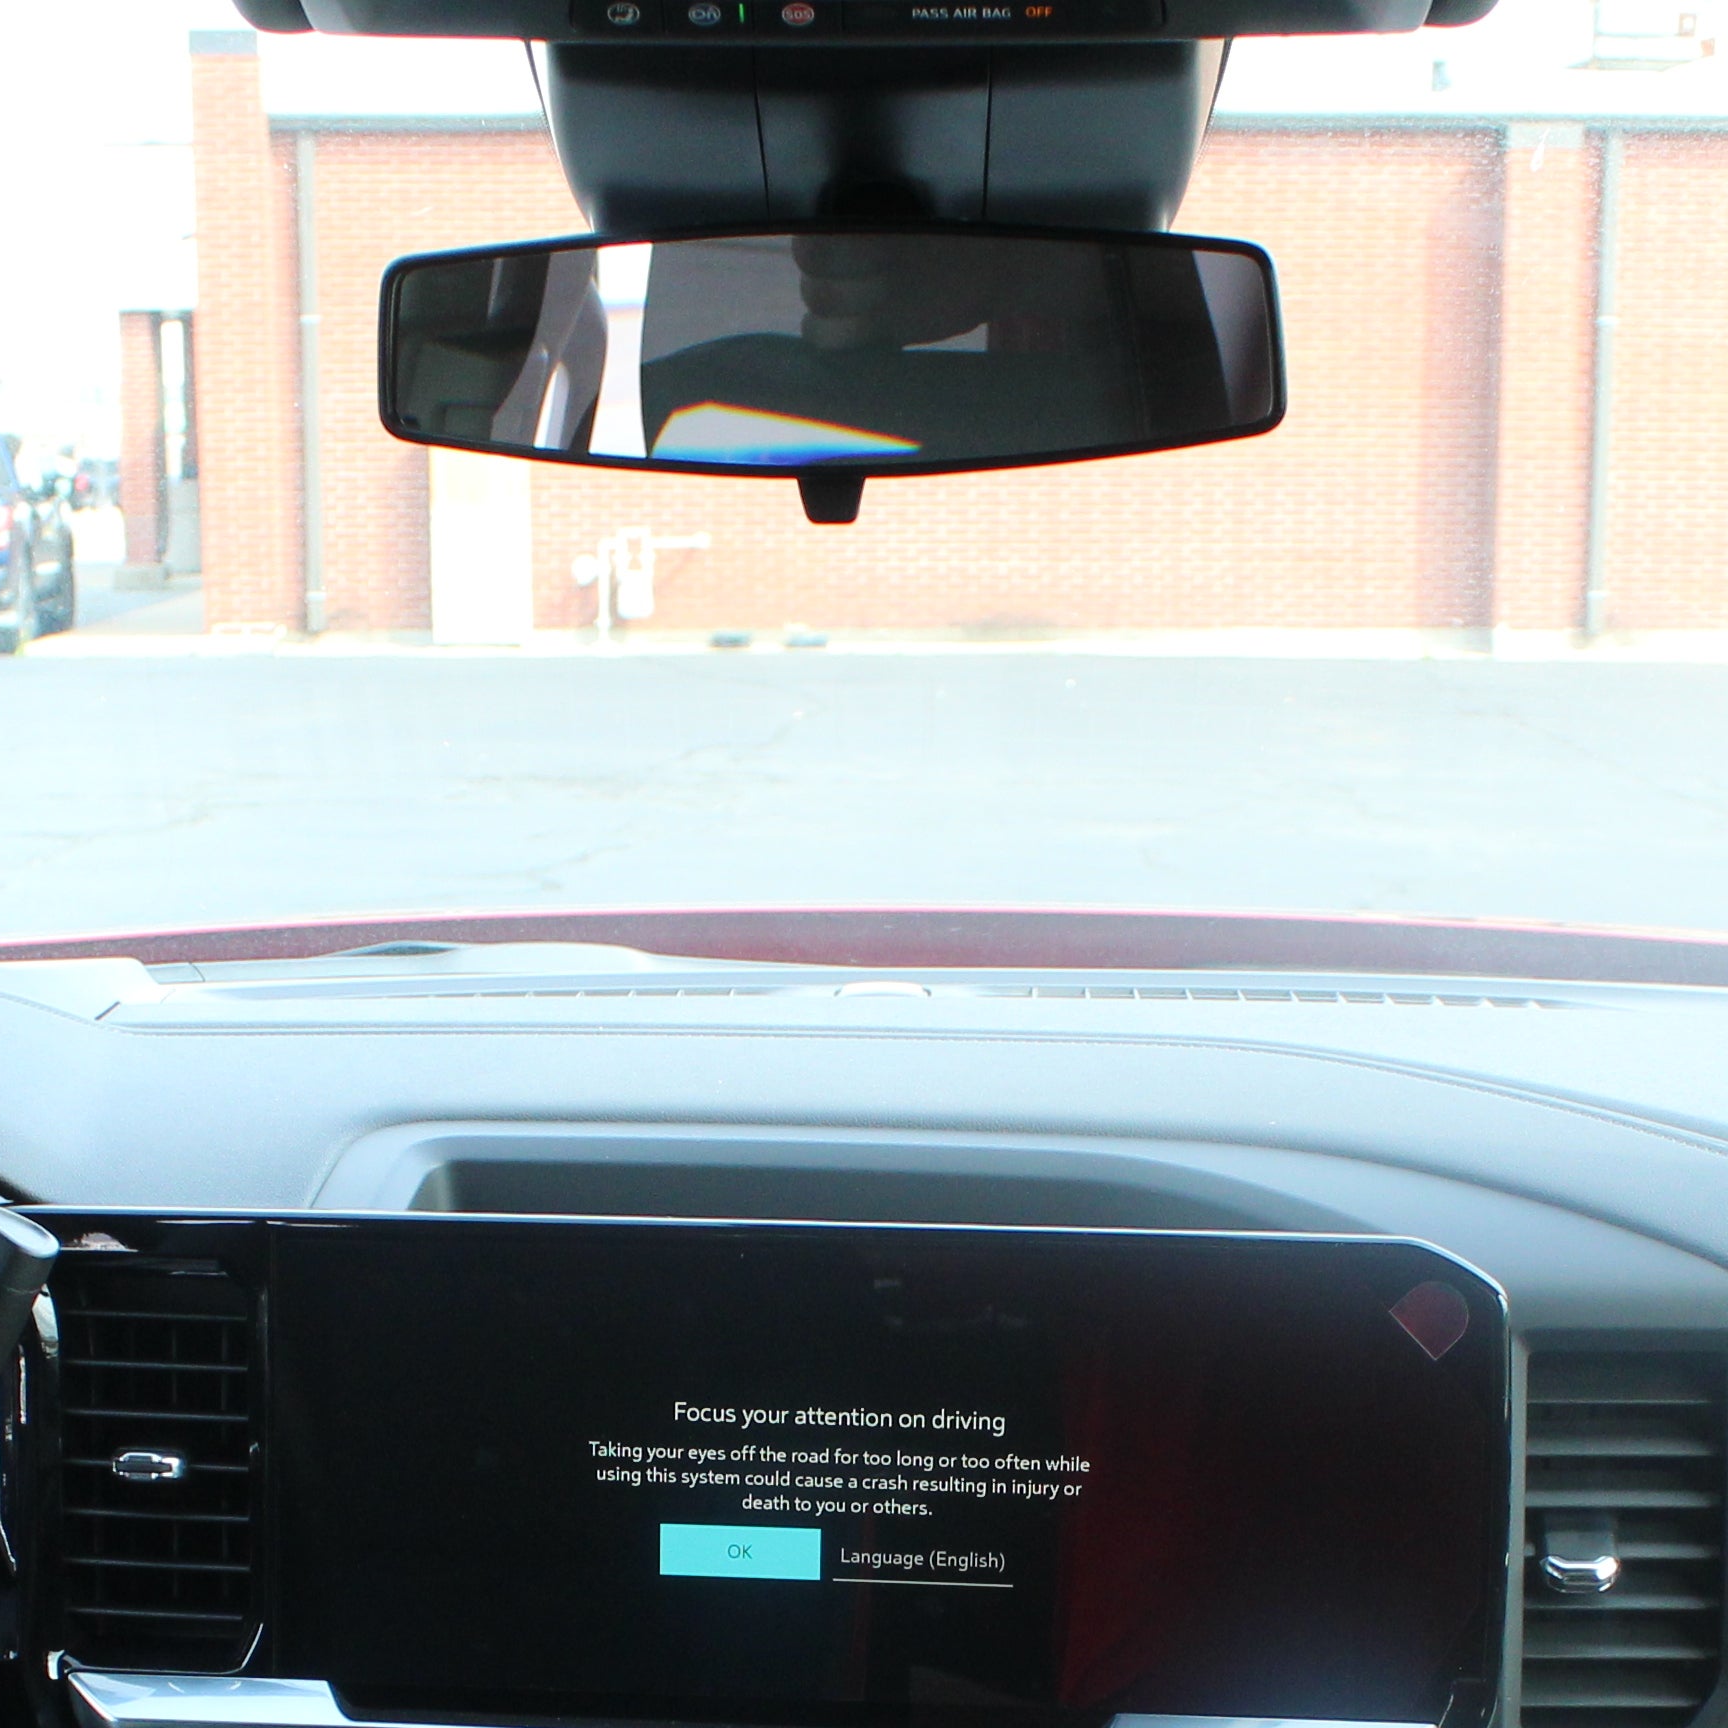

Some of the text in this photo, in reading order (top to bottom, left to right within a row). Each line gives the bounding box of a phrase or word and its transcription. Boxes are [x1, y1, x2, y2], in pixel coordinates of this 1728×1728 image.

[785, 7, 811, 20] SOS
[913, 7, 1051, 18] PASS AIR BAG OFF
[675, 1402, 1005, 1436] Focus your attention on driving
[589, 1441, 1090, 1472] Taking your eyes off the road for too long or too often while
[597, 1467, 1082, 1499] using this system could cause a crash resulting in injury or
[743, 1494, 932, 1516] death to you or others.
[728, 1544, 753, 1560] OK
[841, 1548, 1004, 1572] Language (English)
